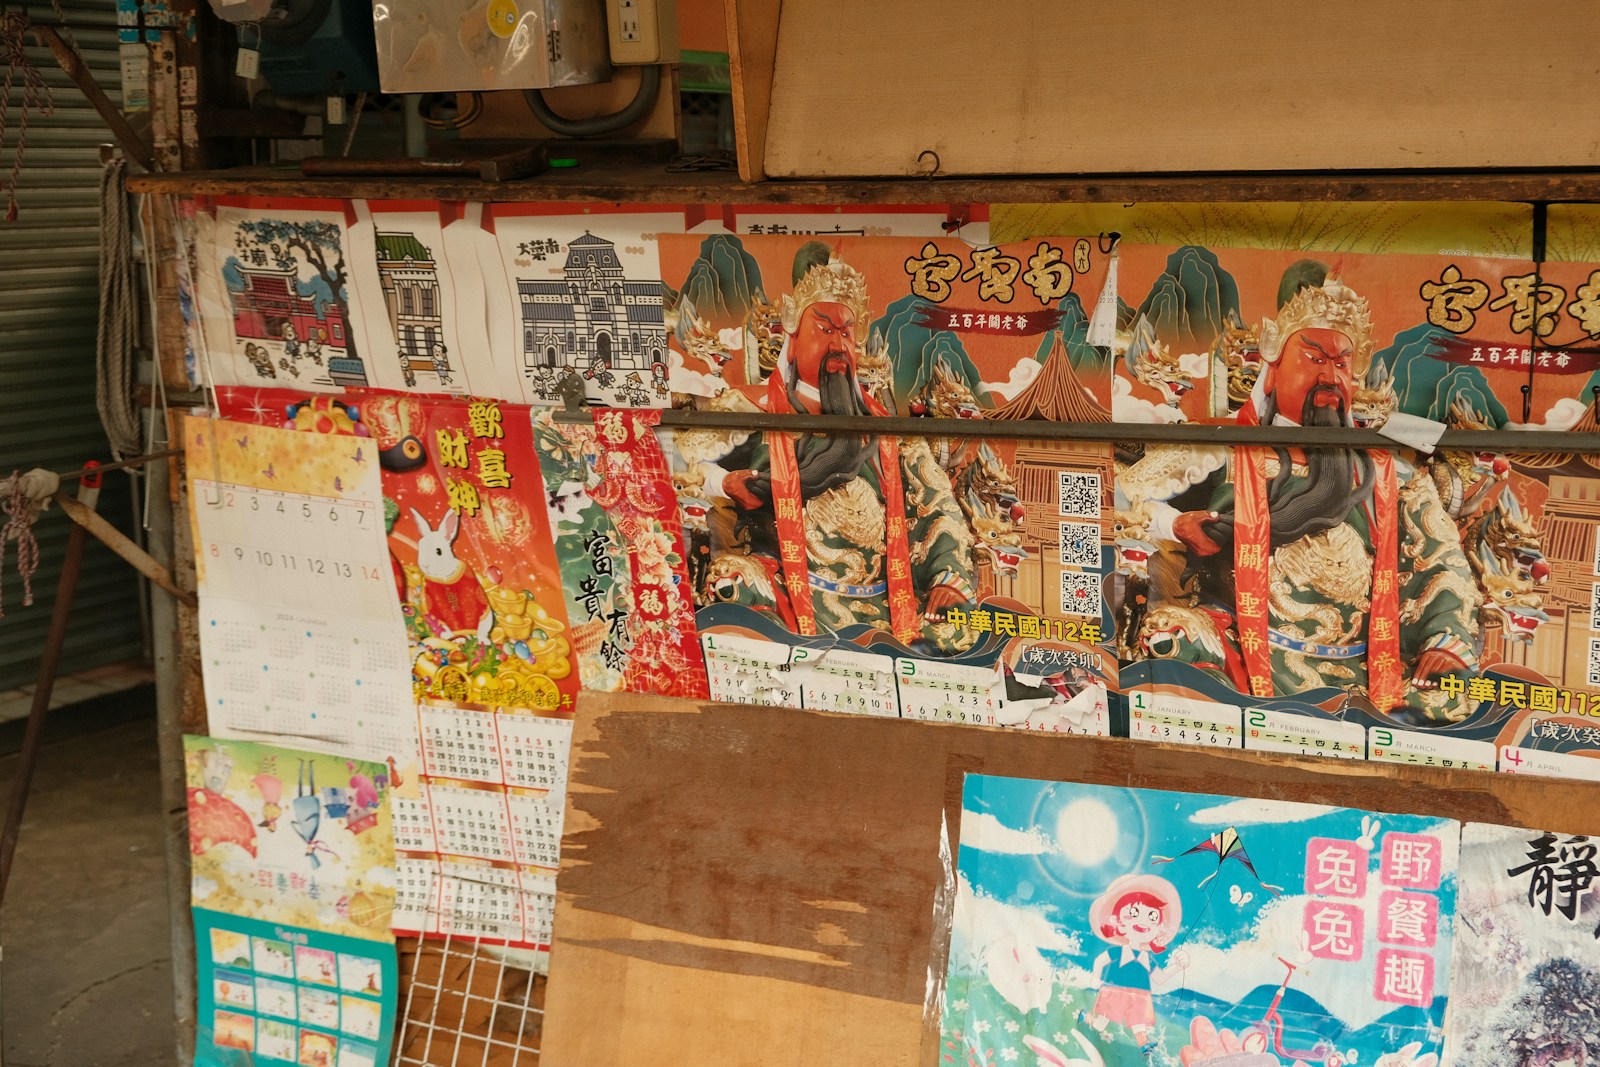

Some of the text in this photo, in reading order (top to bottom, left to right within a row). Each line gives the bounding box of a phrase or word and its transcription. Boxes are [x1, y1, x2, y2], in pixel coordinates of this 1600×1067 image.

[517, 238, 560, 261] 大菜市
[948, 314, 1028, 330] 五百年關老爺
[600, 412, 628, 444] 福
[468, 402, 512, 488] 歡喜
[436, 429, 481, 517] 財神
[226, 493, 234, 507] 2
[251, 497, 259, 511] 3
[277, 501, 285, 513] 4
[303, 504, 312, 518] 5
[329, 507, 338, 522] 6
[357, 510, 365, 524] 7
[211, 544, 380, 581] 8 9 10 11 12 13 14
[639, 589, 664, 616] 福
[946, 608, 1102, 646] 中華民國112年
[724, 663, 729, 671] 2
[825, 658, 858, 668] FEBRUARY
[869, 673, 875, 681] 五
[926, 671, 951, 680] MARCH
[714, 677, 731, 687] 8 9
[845, 680, 864, 690] 1 2
[971, 686, 978, 694] 五
[714, 693, 722, 702] 15
[809, 690, 814, 699] 5
[821, 693, 827, 701] 6
[847, 696, 852, 704] 8
[860, 698, 865, 706] 9
[871, 699, 880, 708] 10
[885, 702, 892, 710] 11
[946, 693, 992, 707] 1 2 3 4
[906, 705, 994, 725] 5 6 7 8 9 10 11
[1156, 707, 1191, 716] JANUARY
[1025, 721, 1045, 731] 3 4
[1135, 711, 1142, 719] 日
[1178, 719, 1188, 727] 三
[1194, 721, 1202, 729] 四
[1210, 723, 1218, 732] 五
[1225, 725, 1234, 734] 六
[1137, 722, 1232, 746] 1 2 3 4 5 6 7
[1280, 724, 1322, 736] FEBRUARY
[1251, 730, 1259, 738] 日
[1283, 735, 1292, 743] 二
[1300, 737, 1309, 746] 三
[1333, 742, 1342, 750] 五
[1349, 744, 1359, 753] 六
[515, 748, 522, 756] 10
[1406, 744, 1436, 753] MARCH
[448, 753, 455, 761] 21
[458, 754, 466, 762] 22
[469, 755, 477, 763] 23
[1425, 757, 1436, 765] 三
[439, 764, 447, 772] 27
[528, 762, 546, 771] 18 19
[1537, 764, 1562, 773] APRIL
[539, 776, 548, 784] 26
[1508, 832, 1600, 922] 靜
[1311, 844, 1358, 956] 兔兔
[1383, 836, 1434, 1001] 野餐趣
